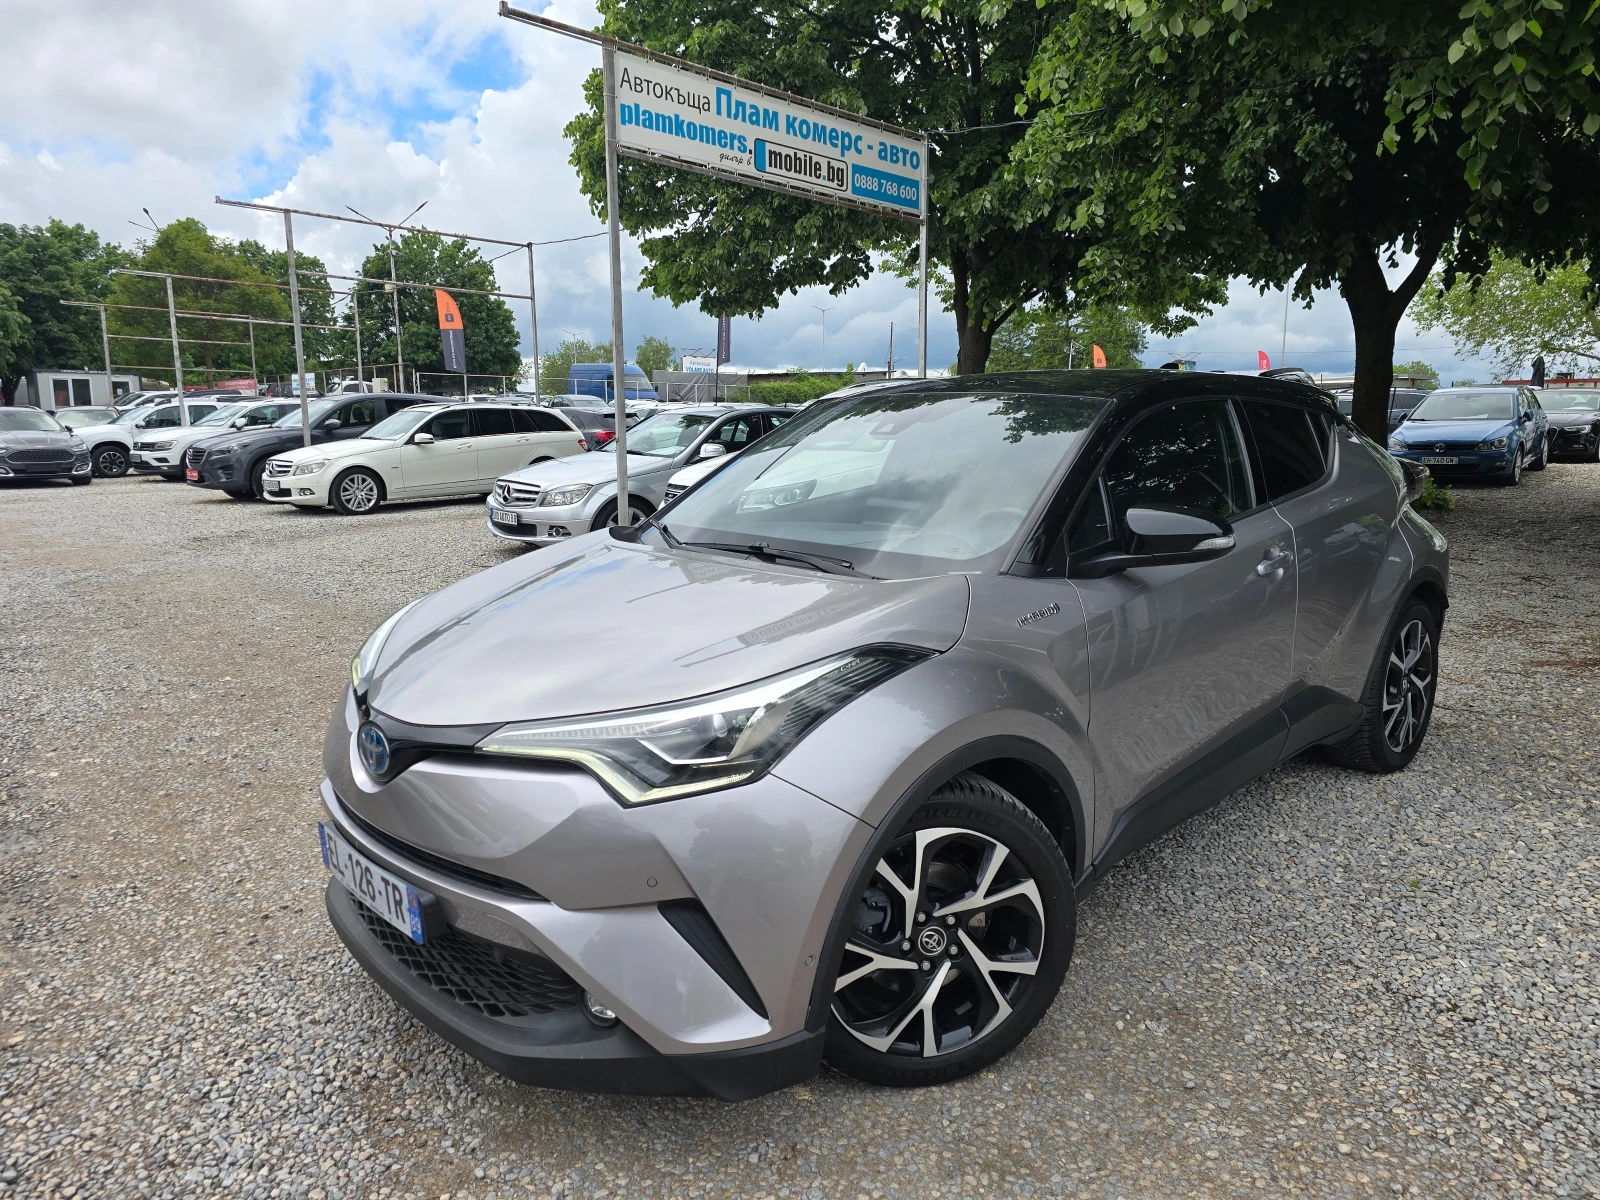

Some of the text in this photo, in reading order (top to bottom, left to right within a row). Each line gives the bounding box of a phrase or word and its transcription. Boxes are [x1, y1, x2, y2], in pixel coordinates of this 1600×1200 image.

[619, 67, 711, 115] Автокъща
[715, 86, 780, 132] Плам
[785, 114, 863, 158] комерс
[877, 141, 921, 170] авто
[768, 148, 845, 188] mobile.bg
[854, 173, 917, 201] 0888 768 600
[1016, 605, 1055, 627] HYBRID
[911, 807, 1001, 826] MICHELIN
